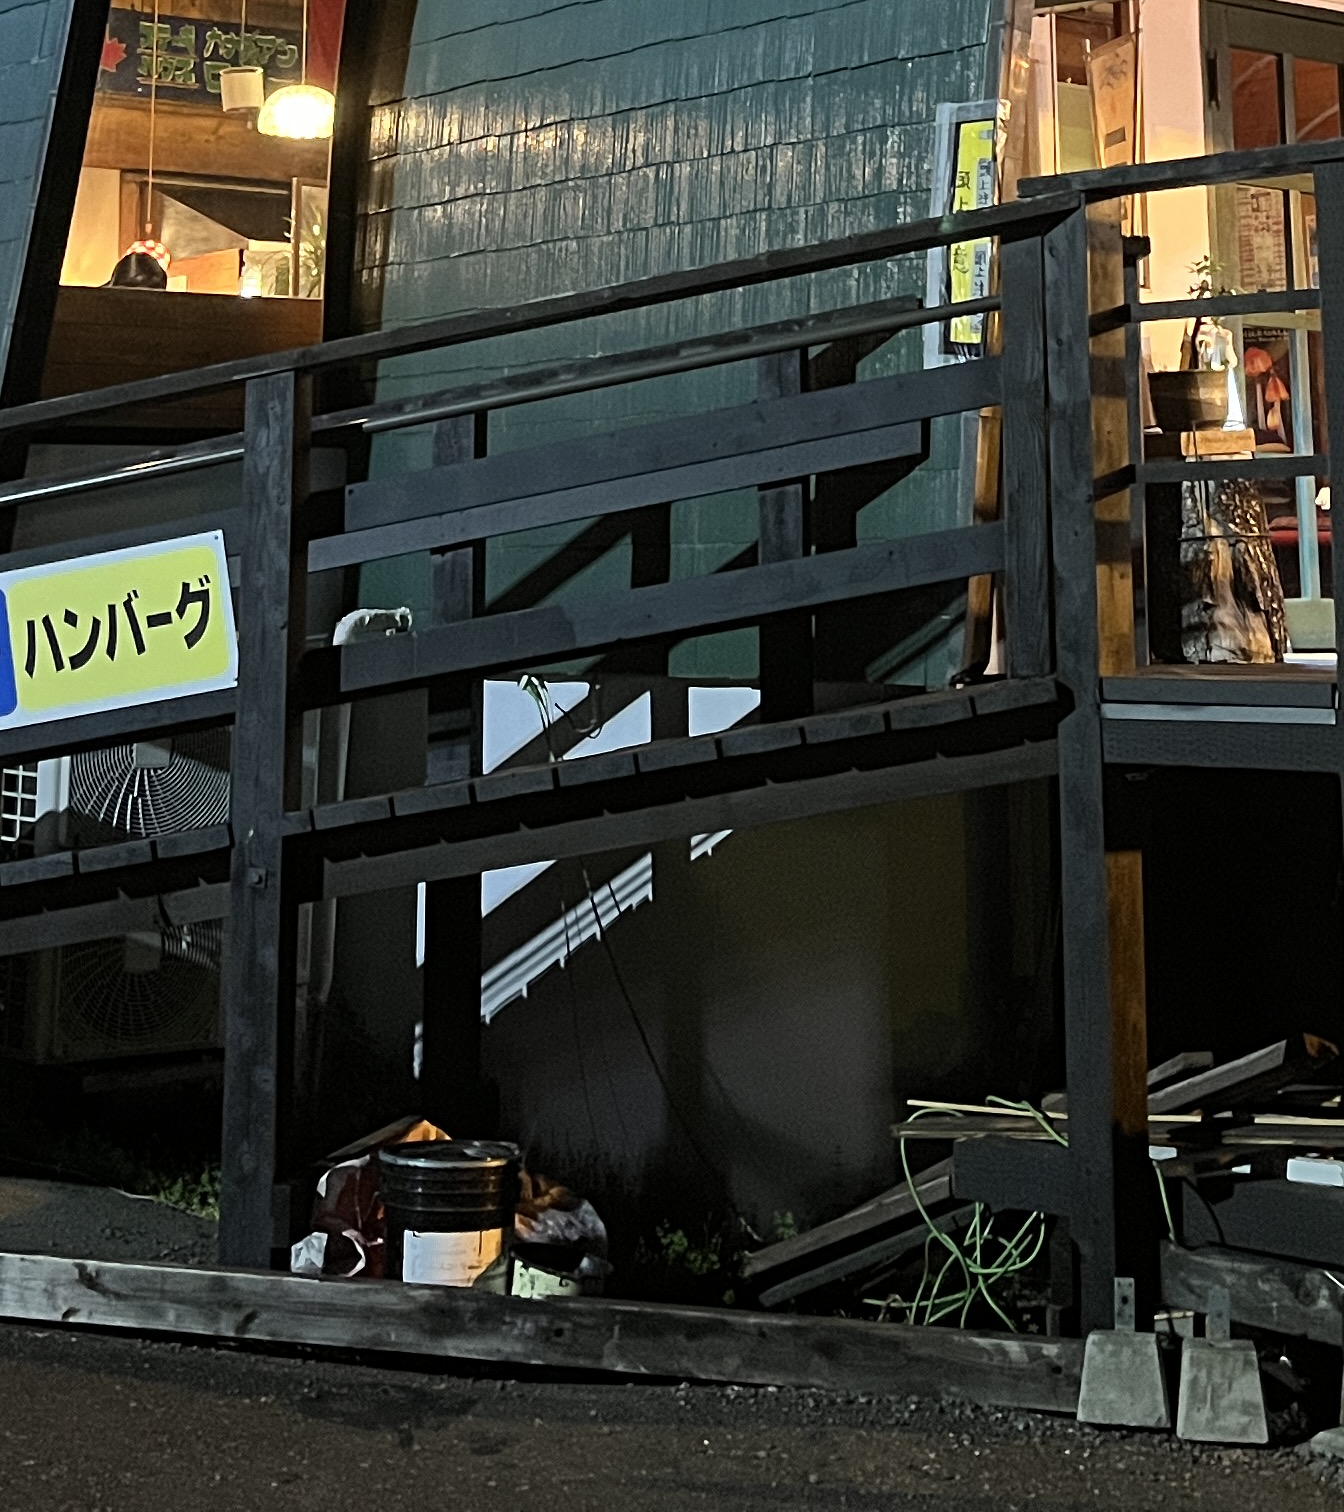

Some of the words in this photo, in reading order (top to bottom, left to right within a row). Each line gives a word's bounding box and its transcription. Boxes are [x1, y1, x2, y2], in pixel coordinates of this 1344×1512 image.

[24, 575, 212, 678] ハンバーグ
